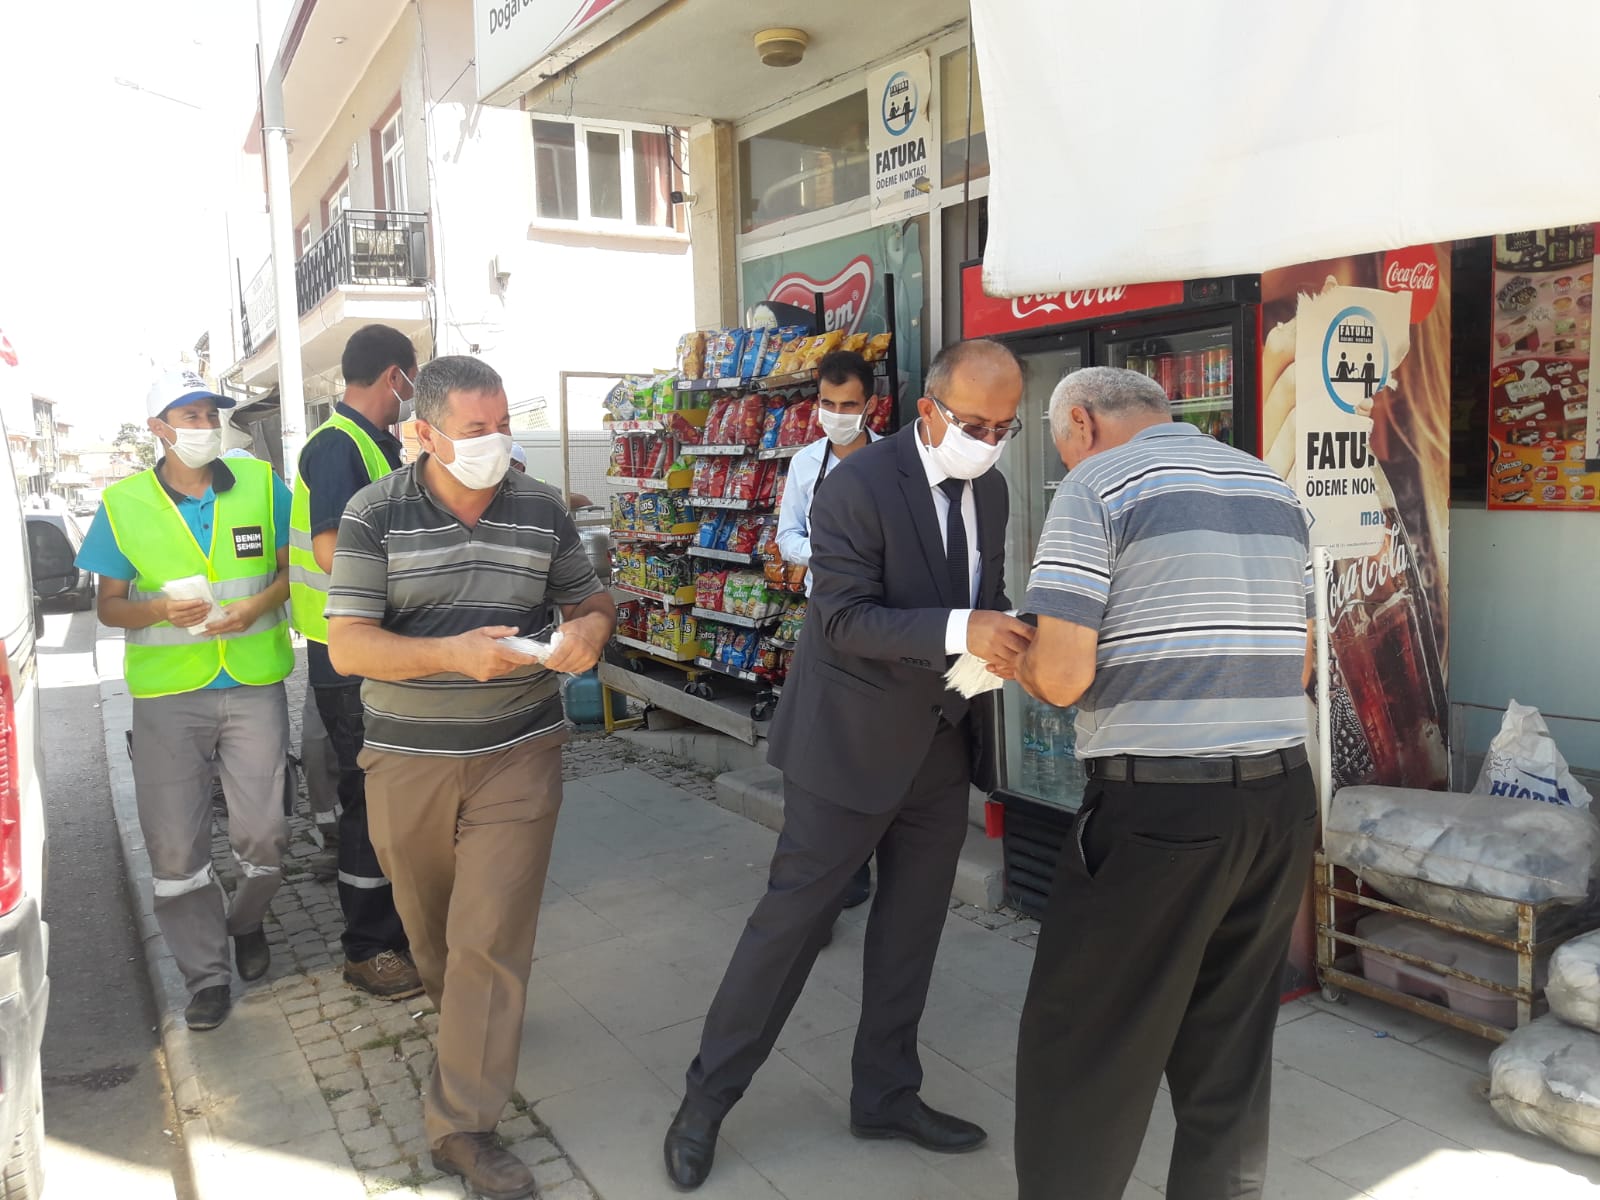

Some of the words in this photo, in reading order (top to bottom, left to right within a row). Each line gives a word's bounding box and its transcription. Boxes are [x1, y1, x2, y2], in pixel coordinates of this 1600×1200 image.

[875, 137, 926, 175] FATURA
[876, 174, 898, 190] ÖDEME
[1386, 260, 1436, 289] Coca-Cola
[1306, 431, 1375, 470] FATU
[1306, 475, 1348, 497] ÖDEME
